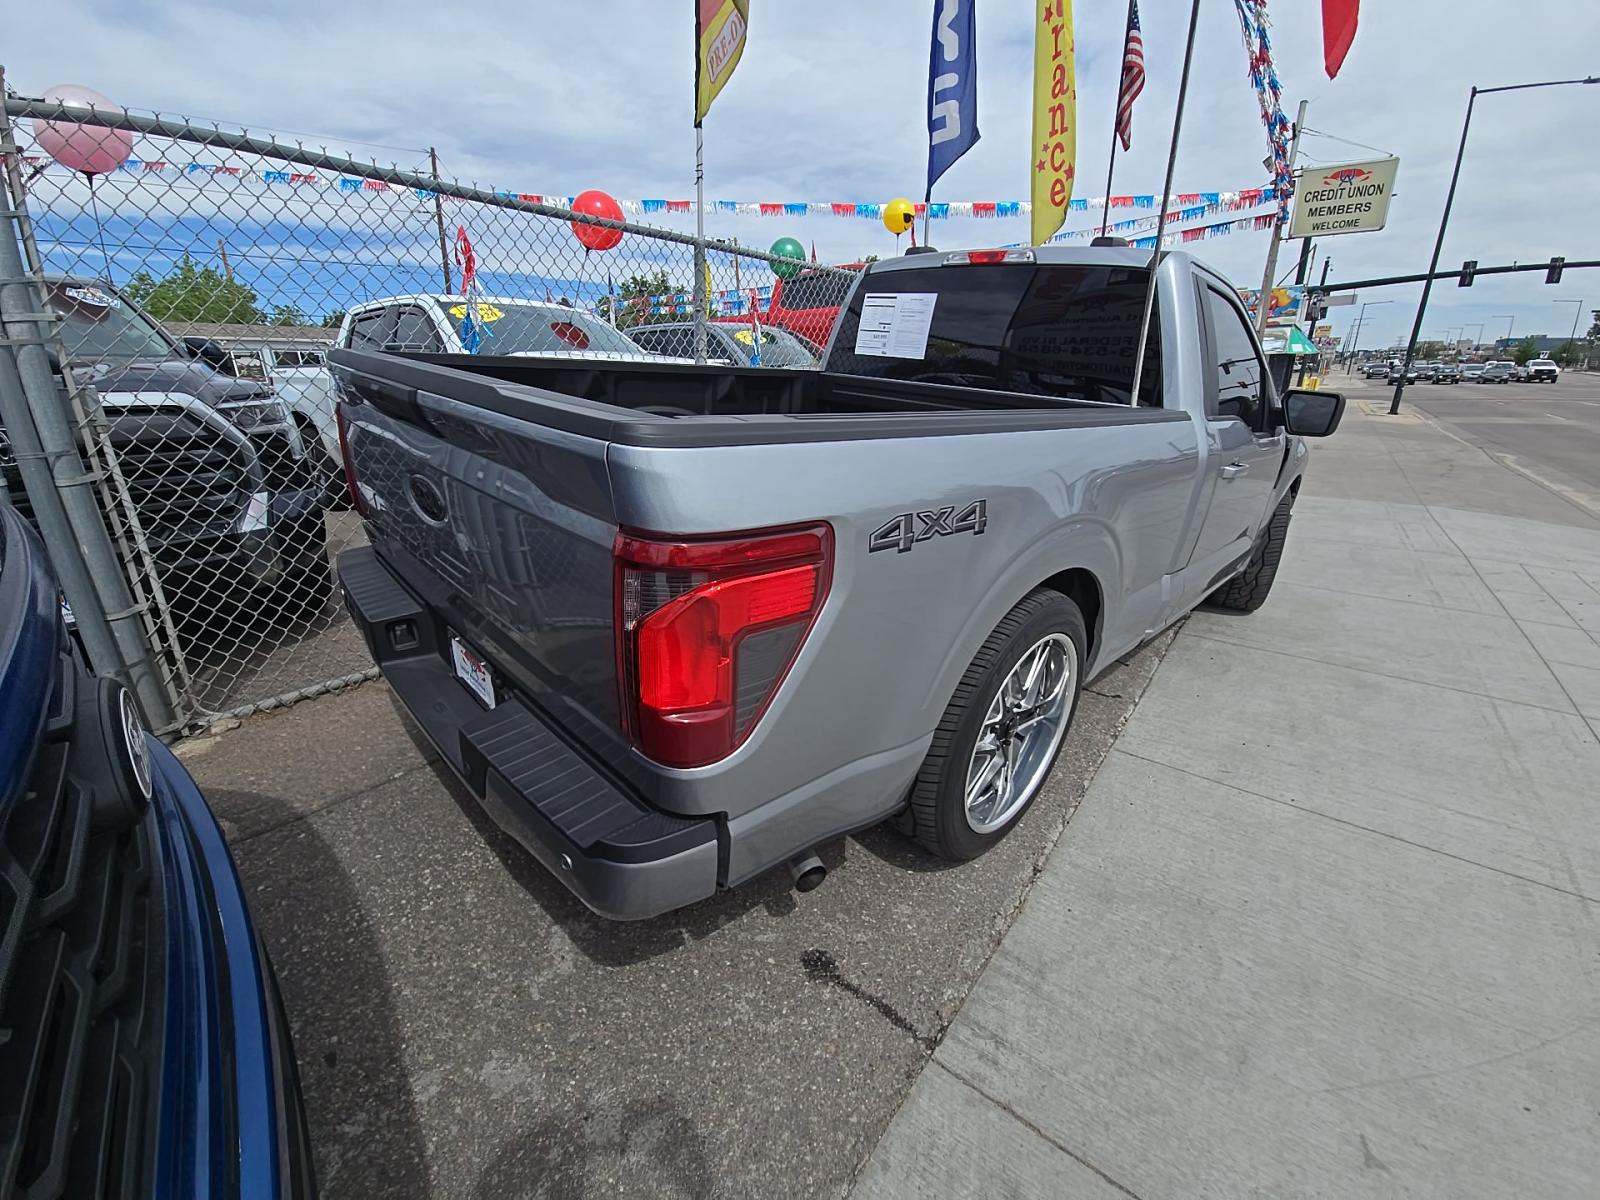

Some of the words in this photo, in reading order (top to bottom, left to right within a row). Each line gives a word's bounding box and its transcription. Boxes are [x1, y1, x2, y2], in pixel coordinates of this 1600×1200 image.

[1304, 187, 1346, 203] CREDIT
[1347, 183, 1385, 199] UNION
[1307, 202, 1372, 218] MEMBERS
[1312, 219, 1360, 231] WELCOME
